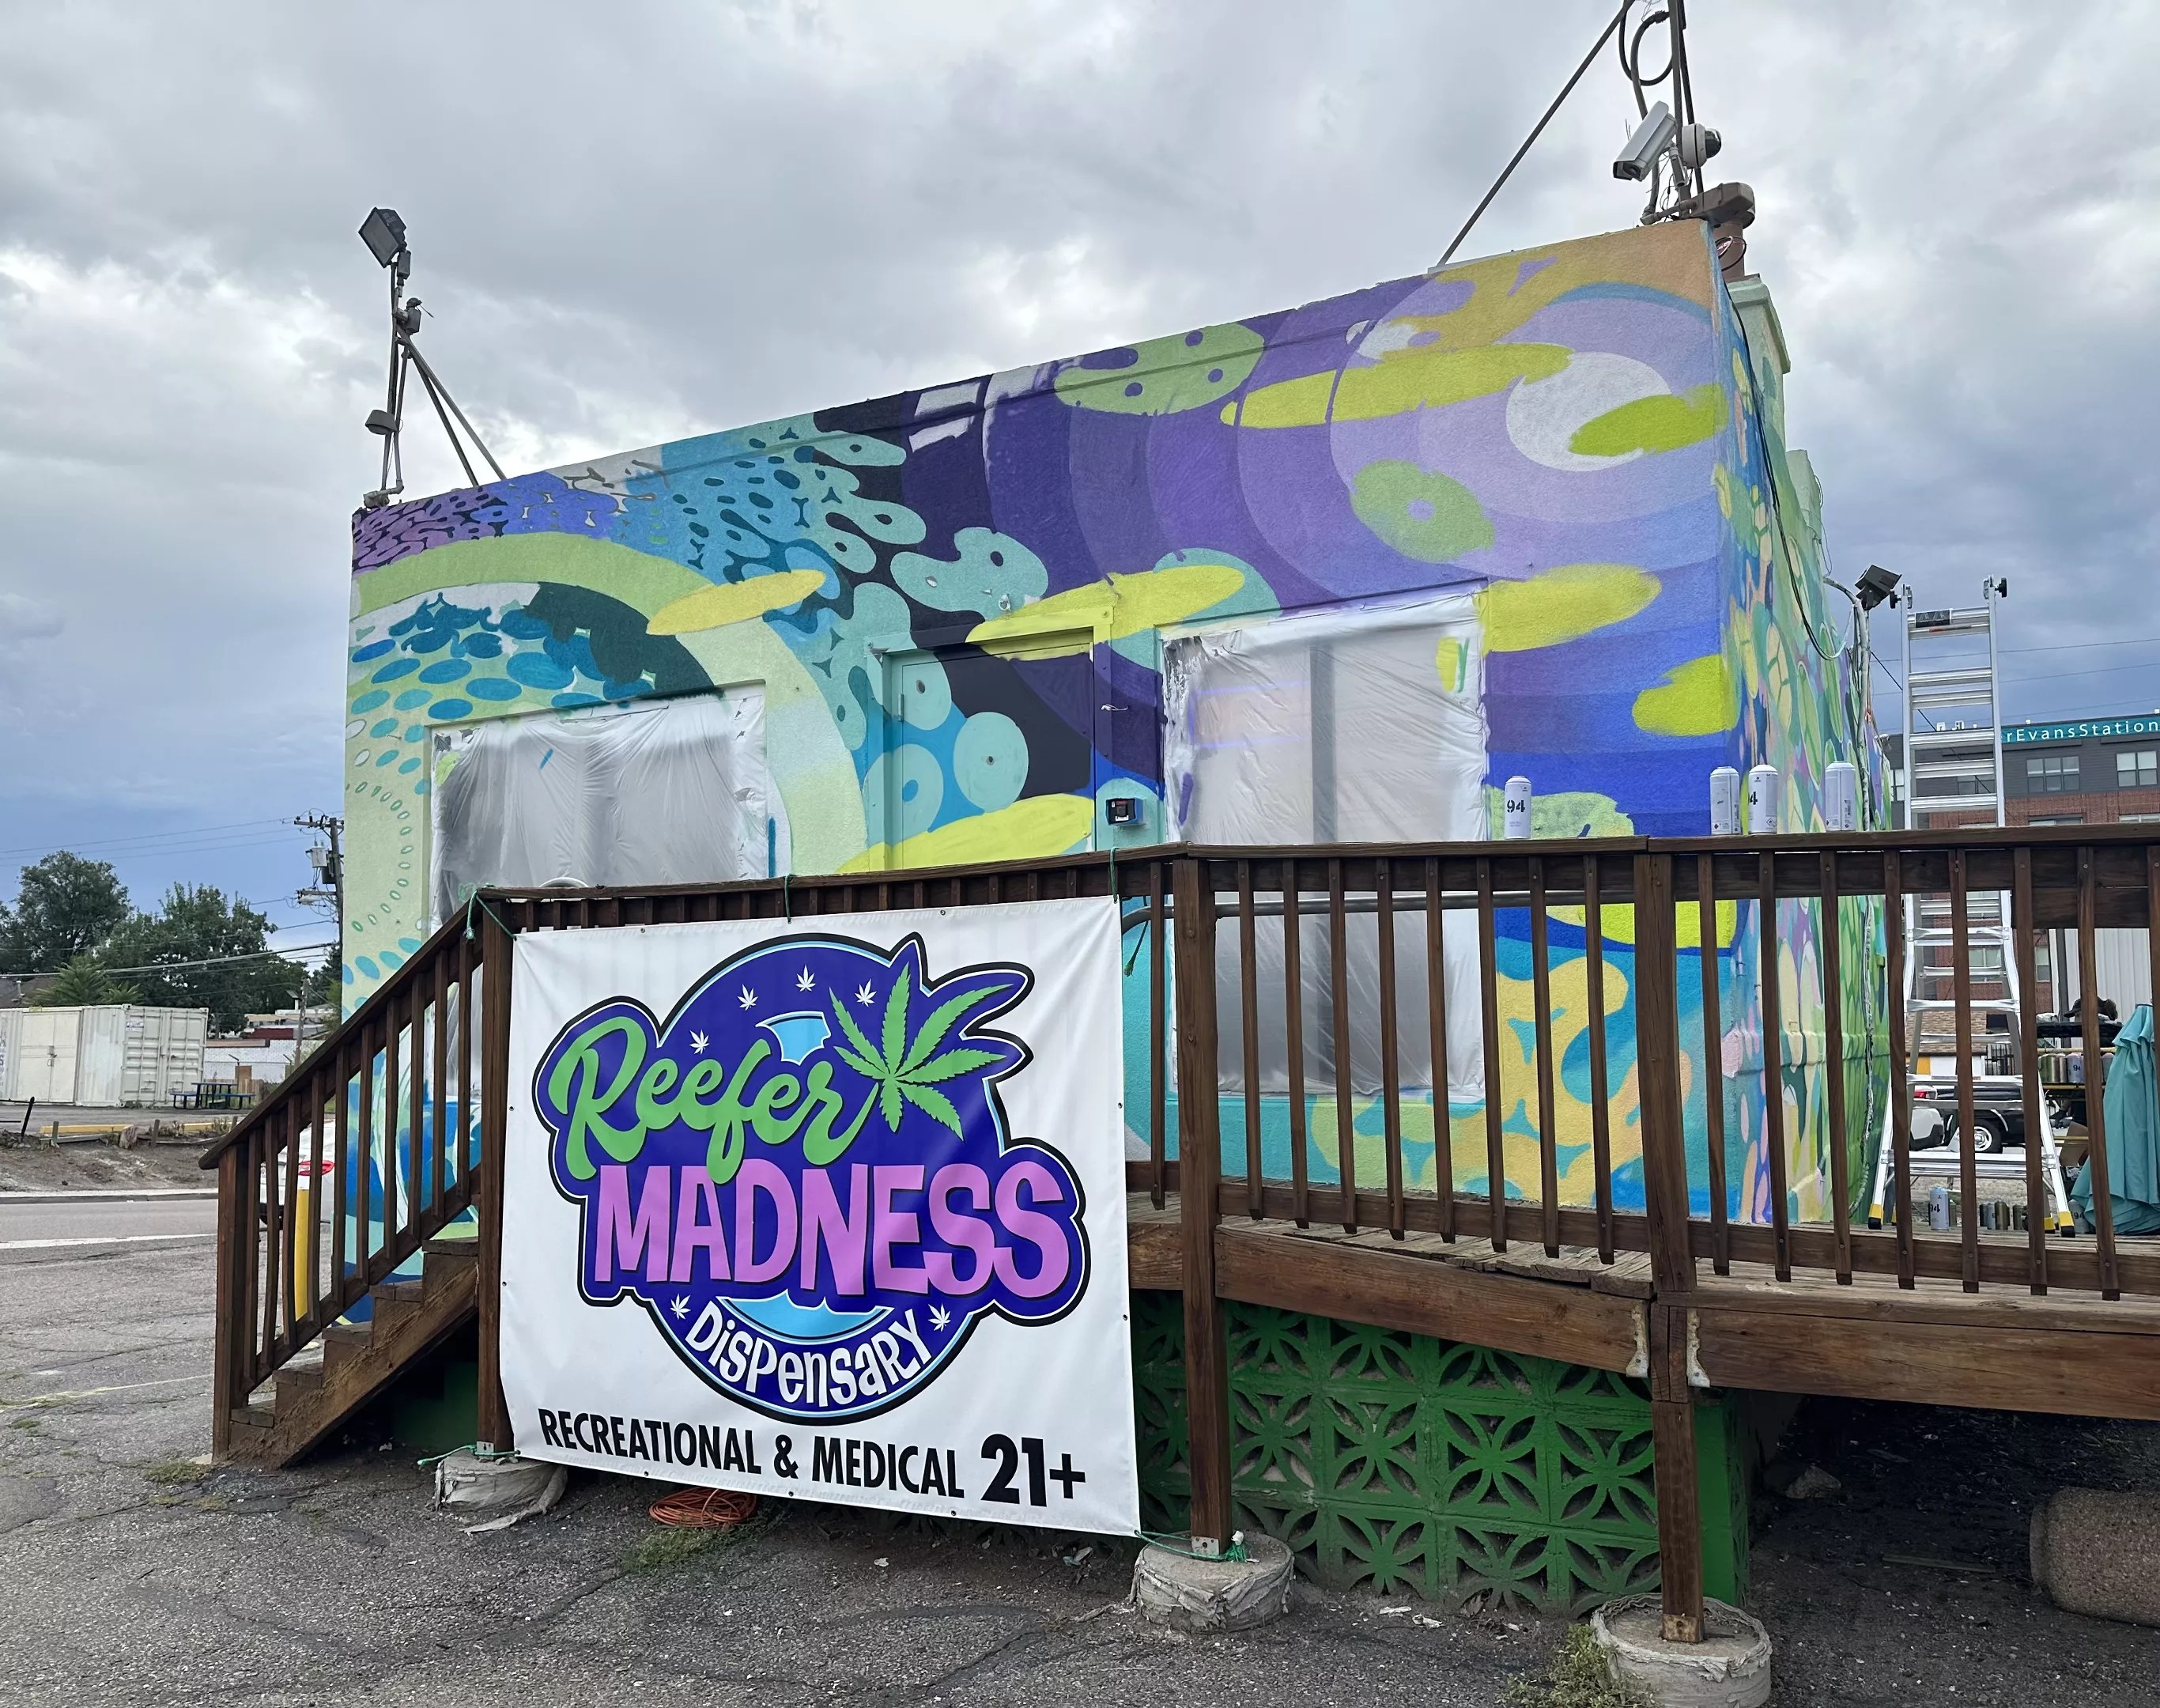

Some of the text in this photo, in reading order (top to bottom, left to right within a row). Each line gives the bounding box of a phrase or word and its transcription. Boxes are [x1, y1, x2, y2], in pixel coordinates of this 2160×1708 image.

[1506, 799, 1526, 814] 94
[1747, 791, 1758, 806] 4
[547, 1016, 878, 1184] Reefer
[595, 1161, 1070, 1298] MADNESS
[538, 1408, 1086, 1507] RECREATIONAL & MEDICAL 21+
